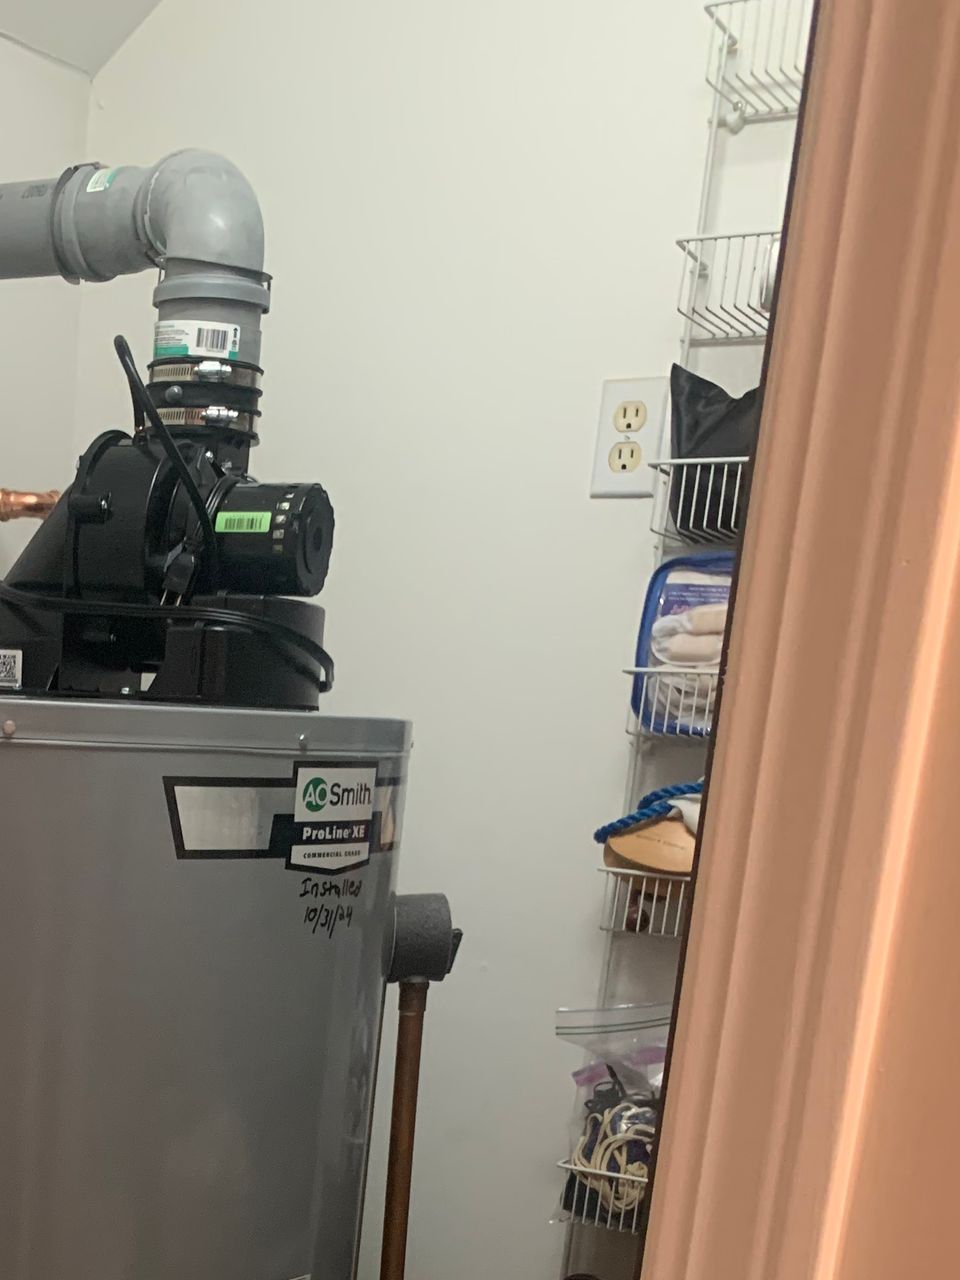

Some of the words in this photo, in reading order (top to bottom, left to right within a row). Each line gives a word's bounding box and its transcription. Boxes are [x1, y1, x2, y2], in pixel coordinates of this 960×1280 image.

[330, 783, 372, 806] Smith
[302, 825, 350, 841] ProLine
[352, 825, 366, 838] XE
[303, 851, 342, 859] COMMERCIAL
[299, 877, 362, 898] Installed
[303, 904, 353, 939] 10/31/24
